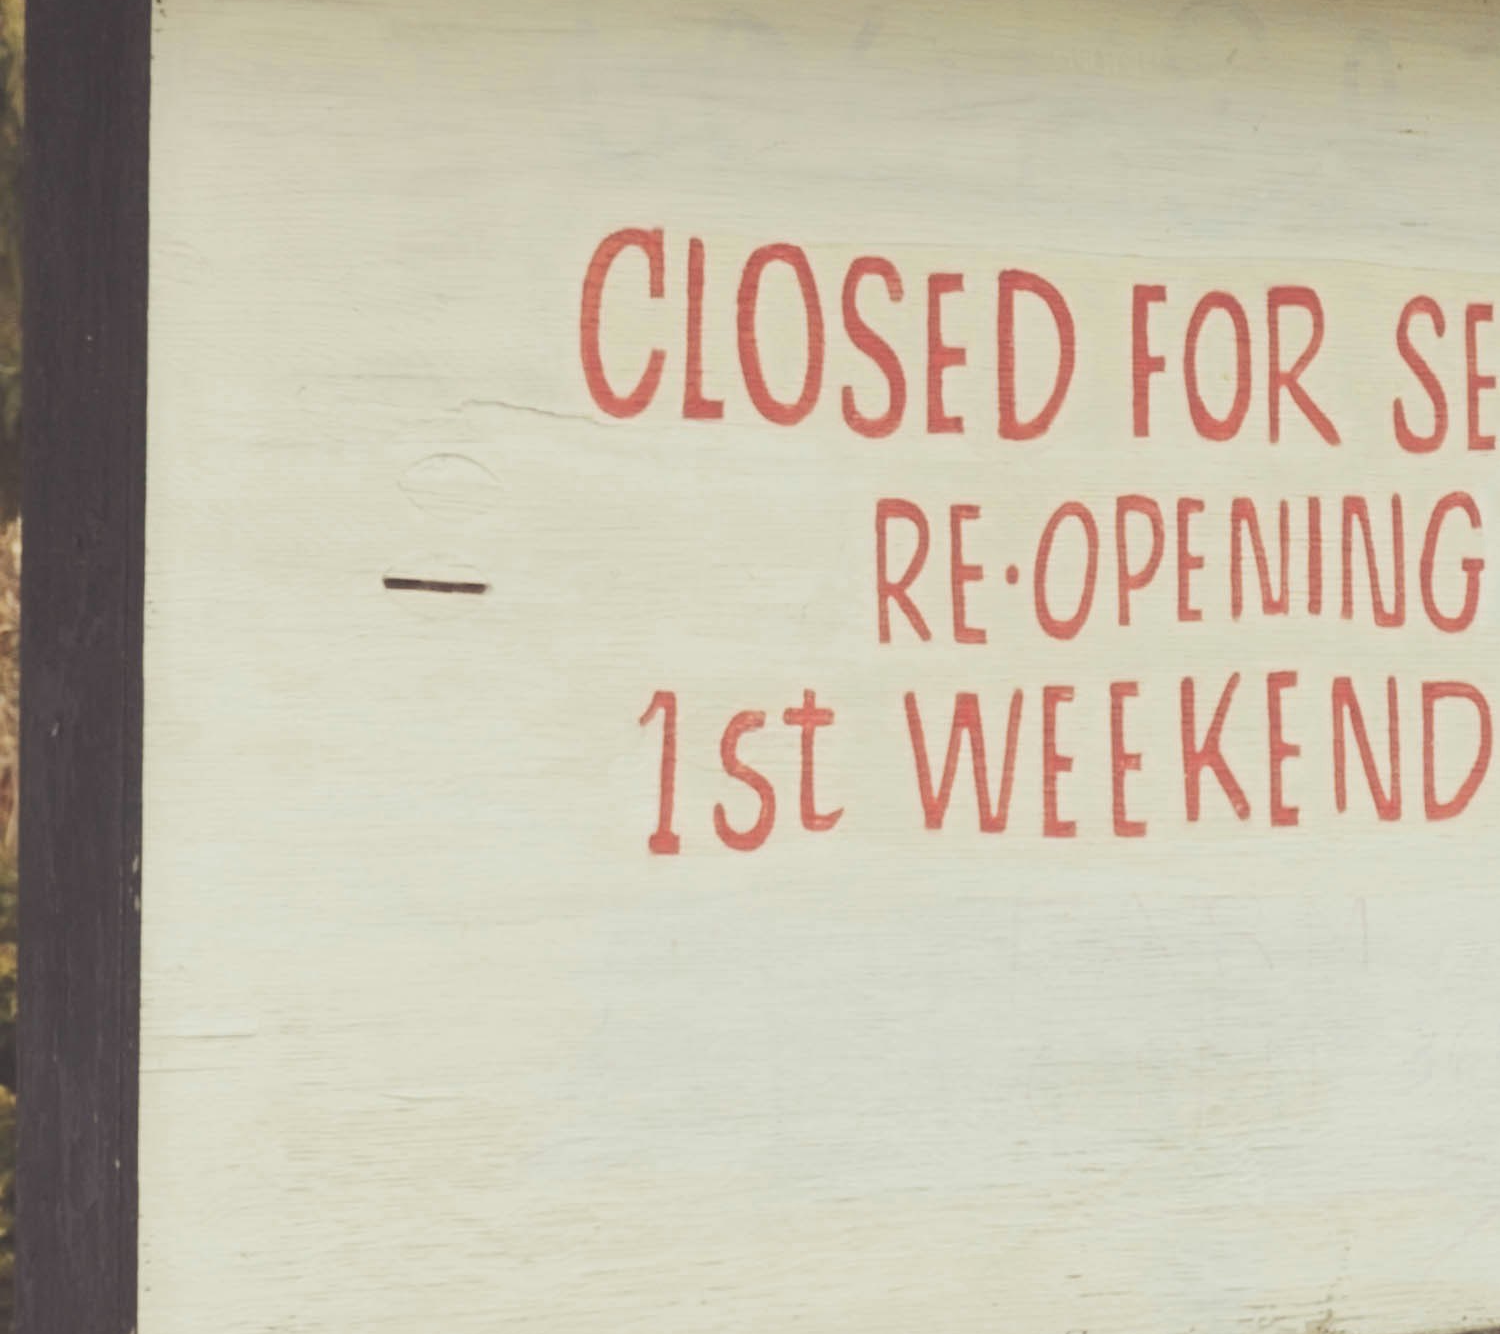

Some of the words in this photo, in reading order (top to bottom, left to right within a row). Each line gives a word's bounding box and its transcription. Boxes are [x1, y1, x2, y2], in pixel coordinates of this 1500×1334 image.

[578, 226, 1077, 444] CLOSED
[1130, 283, 1341, 447] FOR
[638, 685, 843, 857] 1st
[902, 669, 1494, 839] WEEKEND
